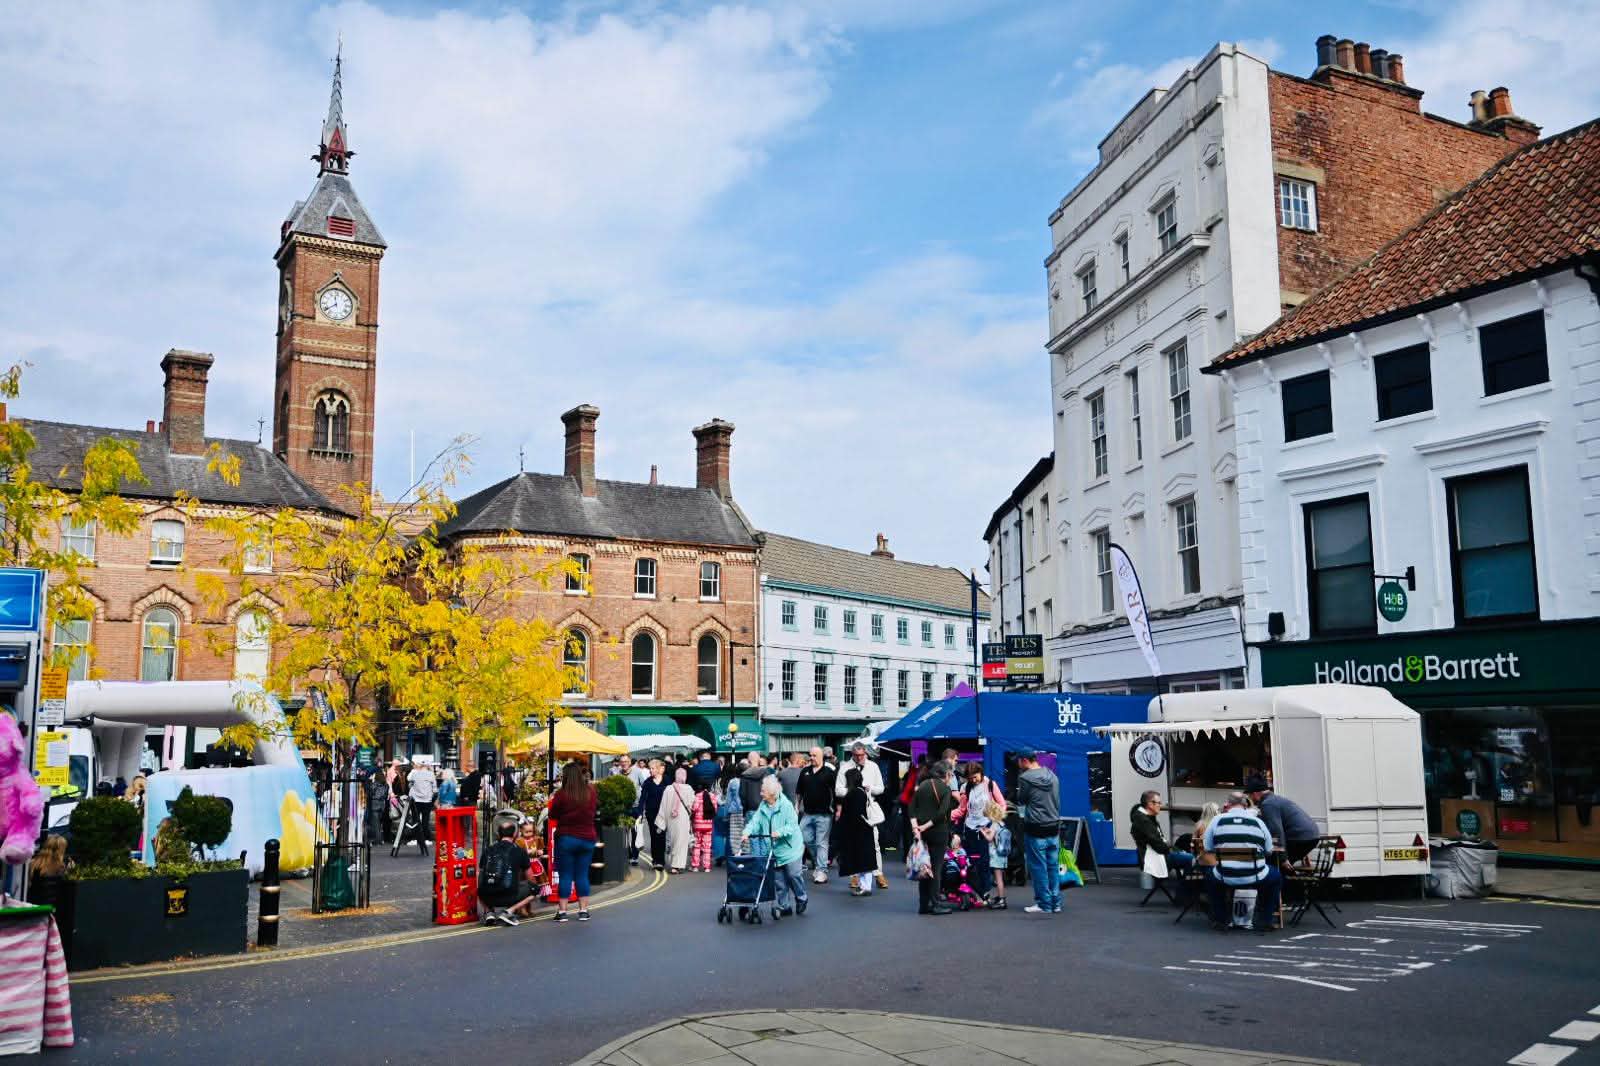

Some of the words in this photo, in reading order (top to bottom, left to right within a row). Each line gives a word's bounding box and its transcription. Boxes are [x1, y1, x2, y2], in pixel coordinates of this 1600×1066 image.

[1012, 637, 1037, 649] TES
[1315, 657, 1404, 684] Holland
[1425, 652, 1520, 681] Barrett
[1056, 698, 1082, 713] blue
[1058, 713, 1082, 727] gnu
